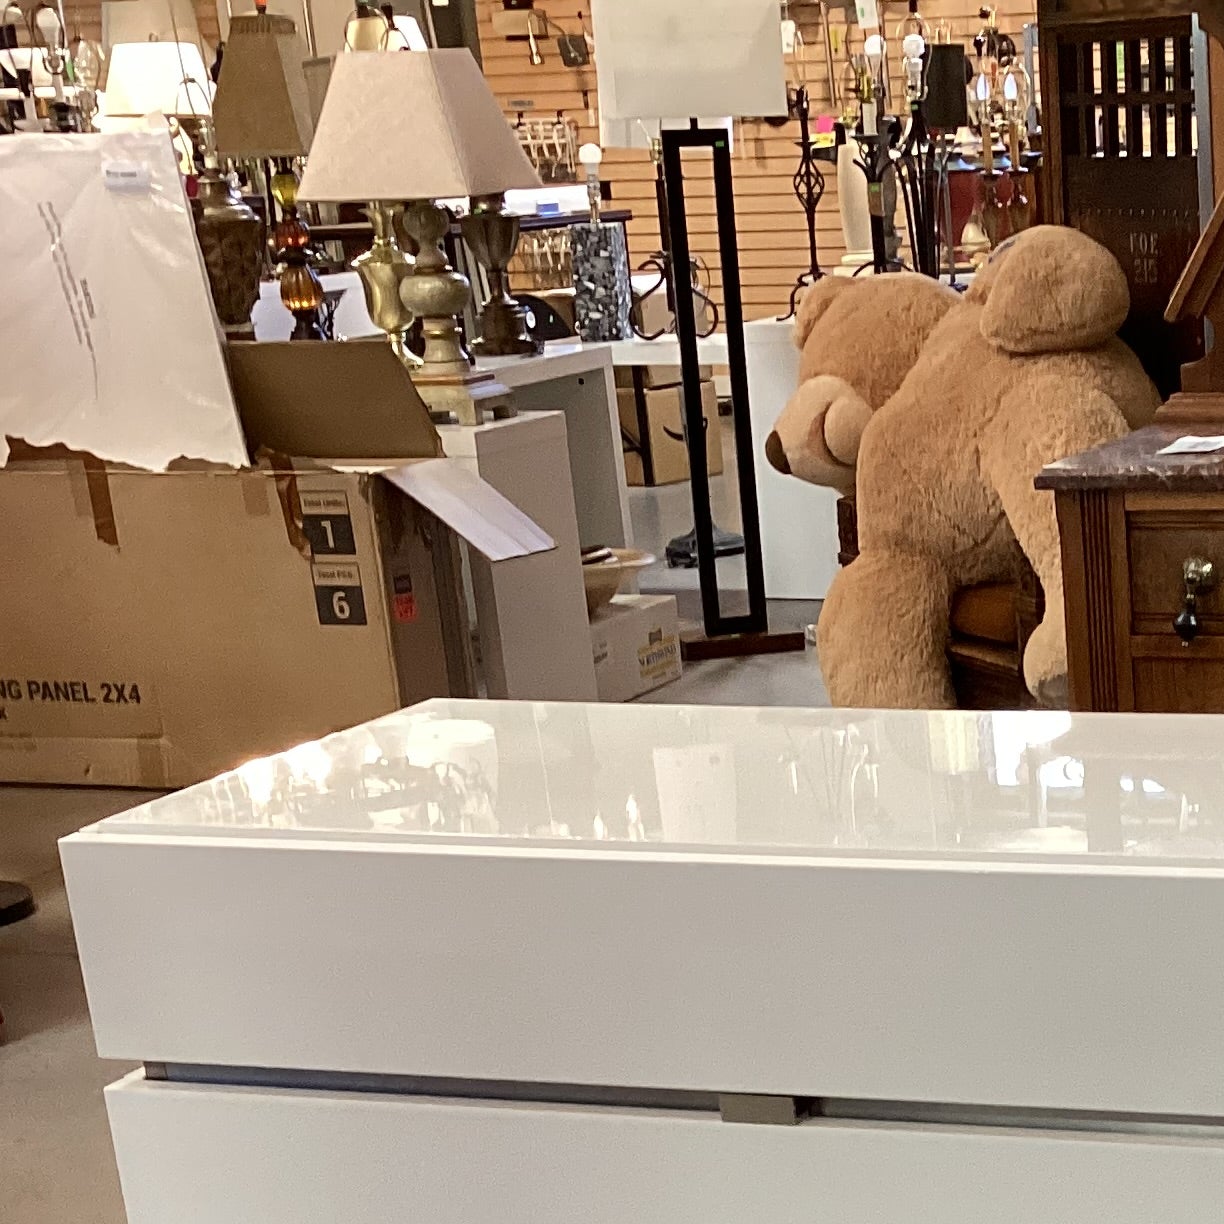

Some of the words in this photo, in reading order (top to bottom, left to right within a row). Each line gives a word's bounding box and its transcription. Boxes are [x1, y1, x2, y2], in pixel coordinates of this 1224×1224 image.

[320, 520, 335, 549] 1
[332, 591, 350, 619] 6
[26, 680, 97, 703] PANEL
[100, 682, 141, 704] 2X4
